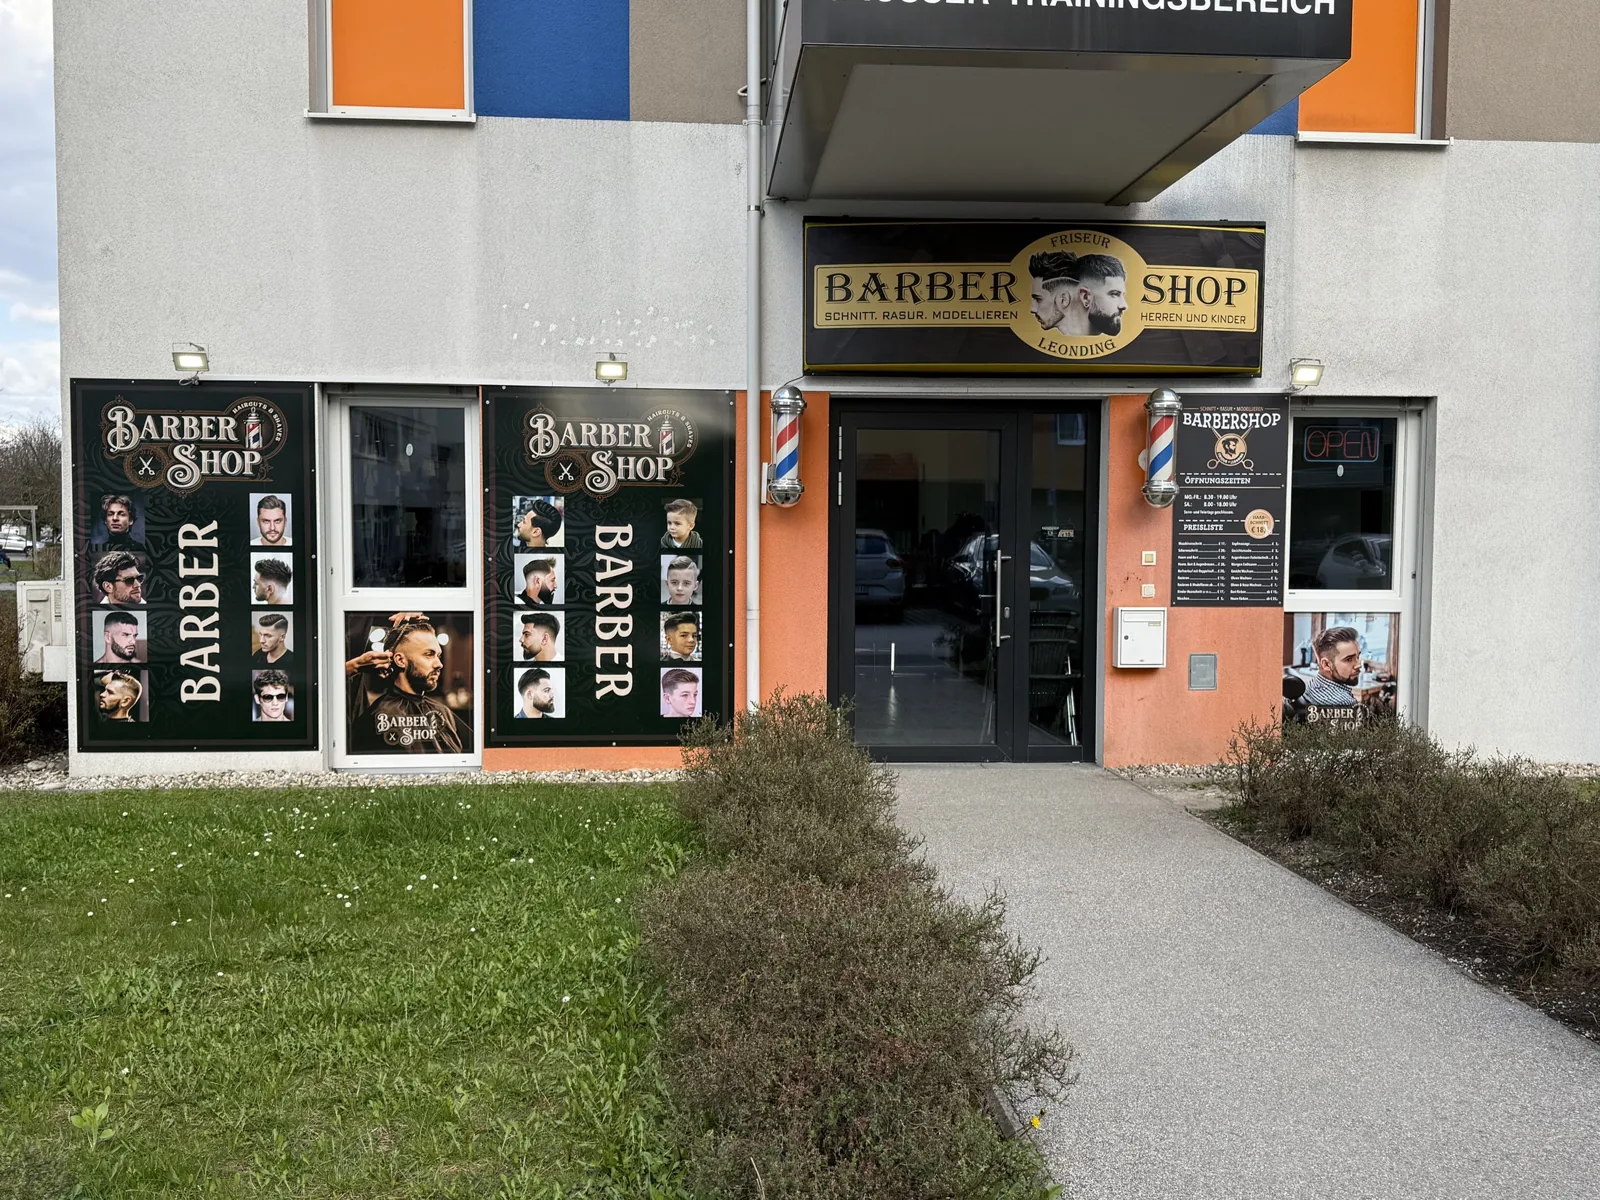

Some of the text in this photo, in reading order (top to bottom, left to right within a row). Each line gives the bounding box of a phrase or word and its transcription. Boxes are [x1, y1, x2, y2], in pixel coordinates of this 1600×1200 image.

[1050, 232, 1111, 249] FRISEUR
[824, 271, 1021, 305] BARBER
[1140, 273, 1248, 307] SHOP
[824, 310, 1018, 321] SCHNITT. RASUR. MODELLIEREN
[1140, 312, 1247, 325] HERREN UND KINDER
[1038, 337, 1117, 357] LEONDING
[107, 405, 240, 453] BARBER
[232, 401, 268, 414] HAIRCUTS
[272, 413, 283, 442] SHAVES
[528, 413, 653, 459] BARBER
[1182, 412, 1281, 430] BARBERSHOP
[1307, 429, 1378, 459] OPEN
[166, 443, 263, 489] SHOP
[585, 450, 675, 494] SHOP
[1184, 476, 1251, 485] ÖFFNUNGSZEITEN
[178, 520, 221, 703] BARBER
[594, 523, 633, 700] BARBER
[377, 713, 428, 733] BARBER
[1307, 704, 1354, 723] BARBER
[400, 727, 437, 746] SHOP
